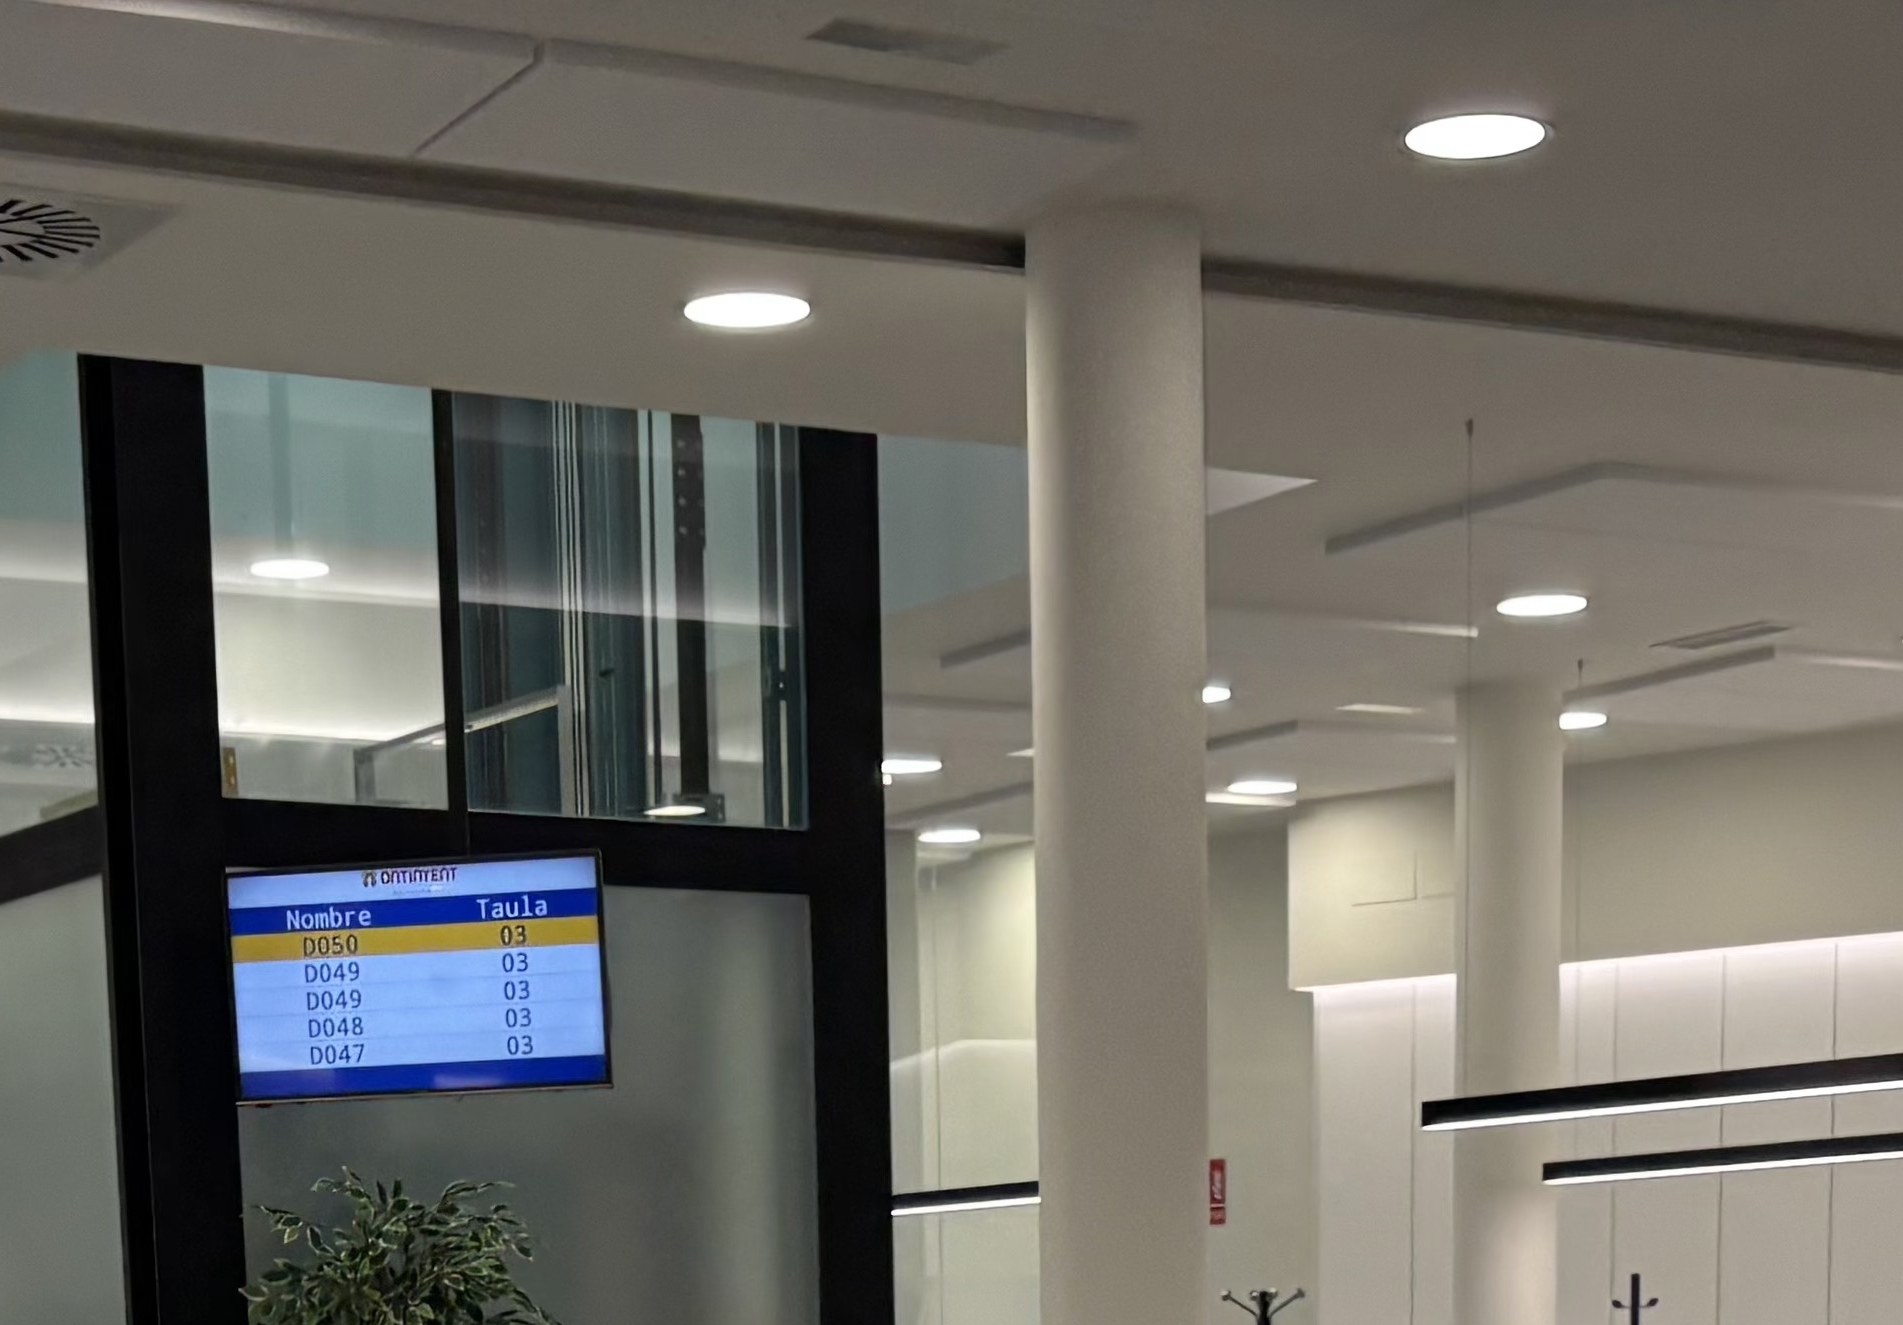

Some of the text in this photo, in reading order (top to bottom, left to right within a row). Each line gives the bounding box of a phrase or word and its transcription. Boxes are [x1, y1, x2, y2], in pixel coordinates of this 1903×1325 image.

[287, 895, 548, 930] Nombre Taula
[303, 925, 527, 956] D050 03
[305, 953, 529, 983] D049 03
[307, 980, 531, 1011] D049 03
[308, 1008, 532, 1038] D048 03
[311, 1035, 533, 1065] D047 03
